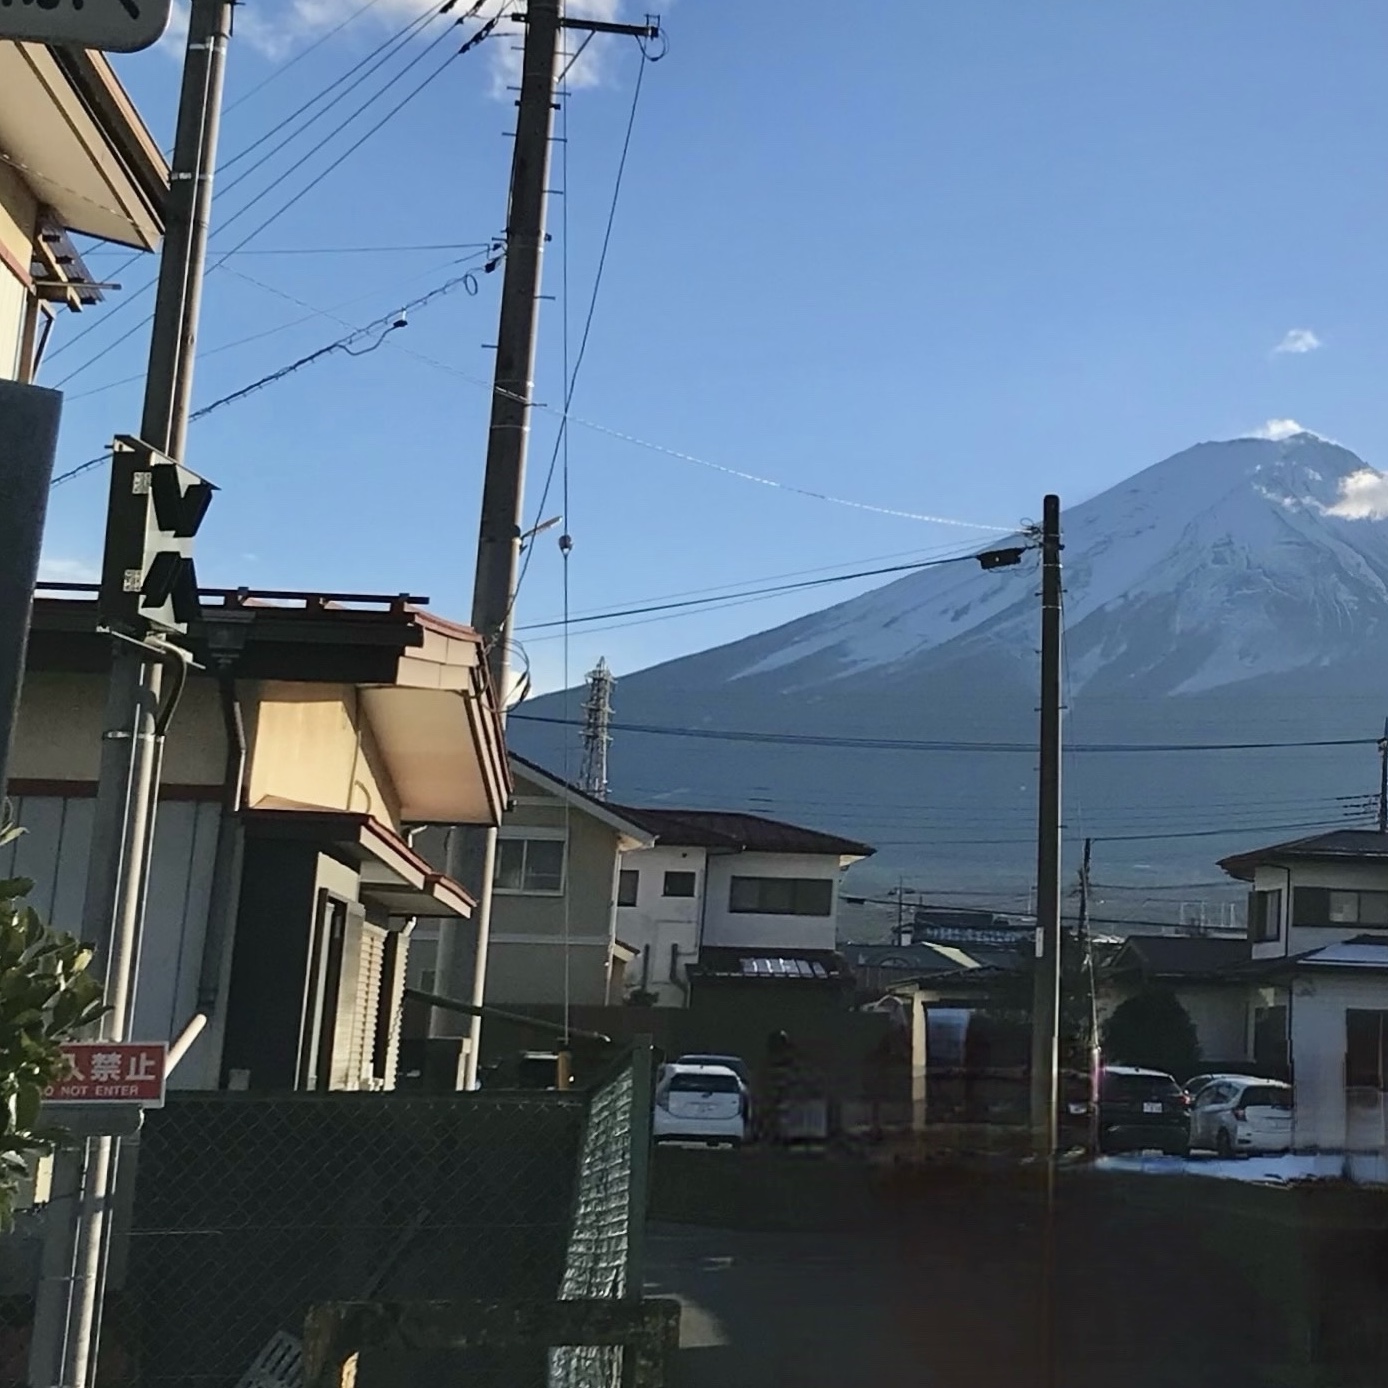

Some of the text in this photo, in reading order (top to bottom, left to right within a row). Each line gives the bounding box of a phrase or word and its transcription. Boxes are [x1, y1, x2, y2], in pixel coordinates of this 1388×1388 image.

[57, 1053, 156, 1081] 入禁止
[61, 1085, 88, 1097] NOT
[95, 1085, 139, 1096] ENTER
